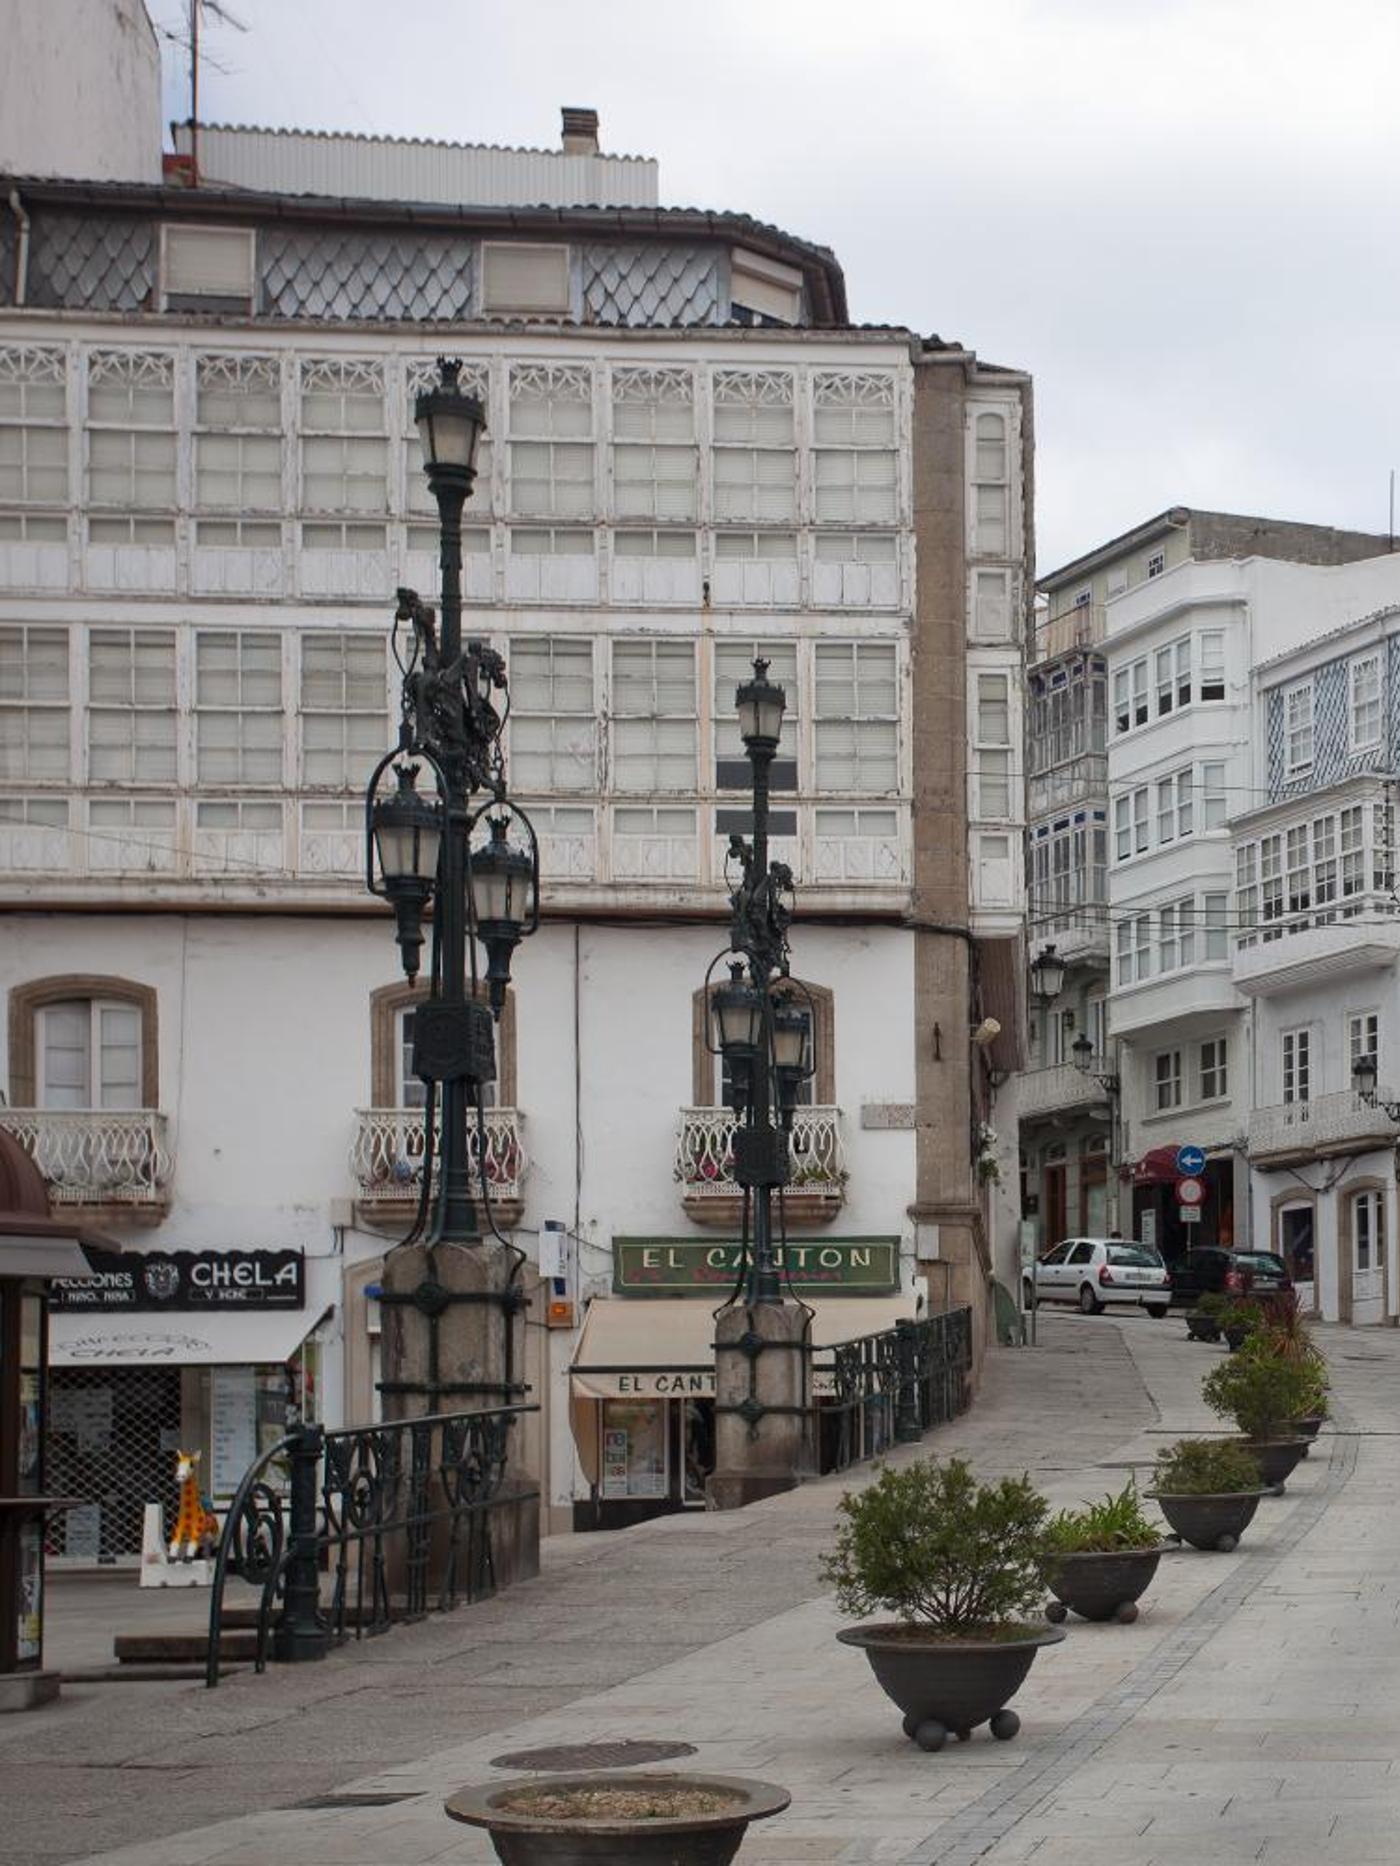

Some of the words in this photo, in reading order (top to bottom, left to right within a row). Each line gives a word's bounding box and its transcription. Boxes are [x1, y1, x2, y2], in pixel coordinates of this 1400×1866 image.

[643, 1248, 685, 1269] EL
[191, 1261, 297, 1286] CHELA
[619, 1376, 642, 1391] EL
[655, 1375, 716, 1392] CANT
